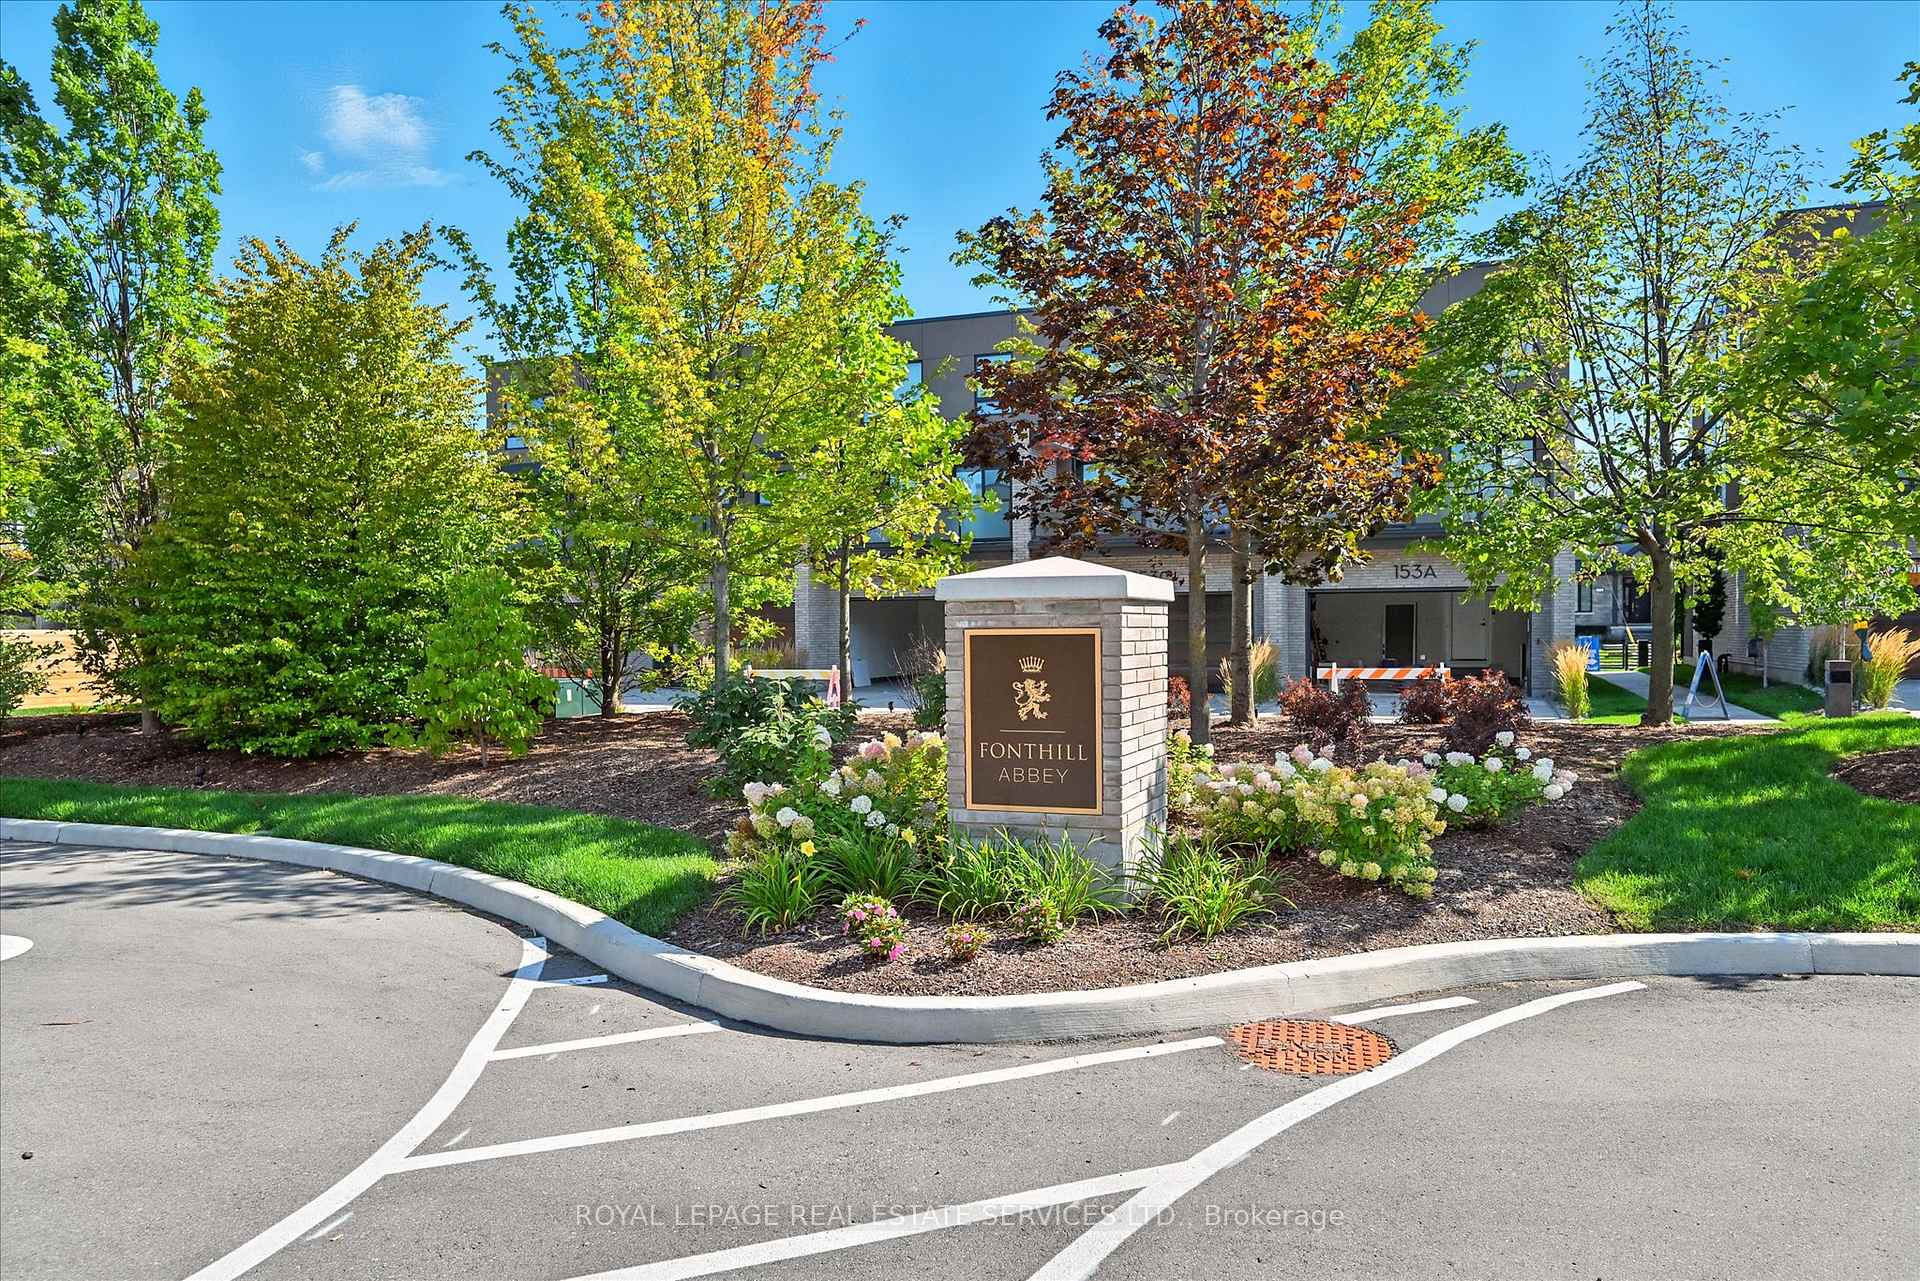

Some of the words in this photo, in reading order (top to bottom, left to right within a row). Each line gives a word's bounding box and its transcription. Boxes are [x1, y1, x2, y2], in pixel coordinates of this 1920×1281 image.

[1393, 564, 1437, 579] 153A
[979, 742, 1089, 761] FONTHILL
[998, 767, 1070, 784] ABBEY
